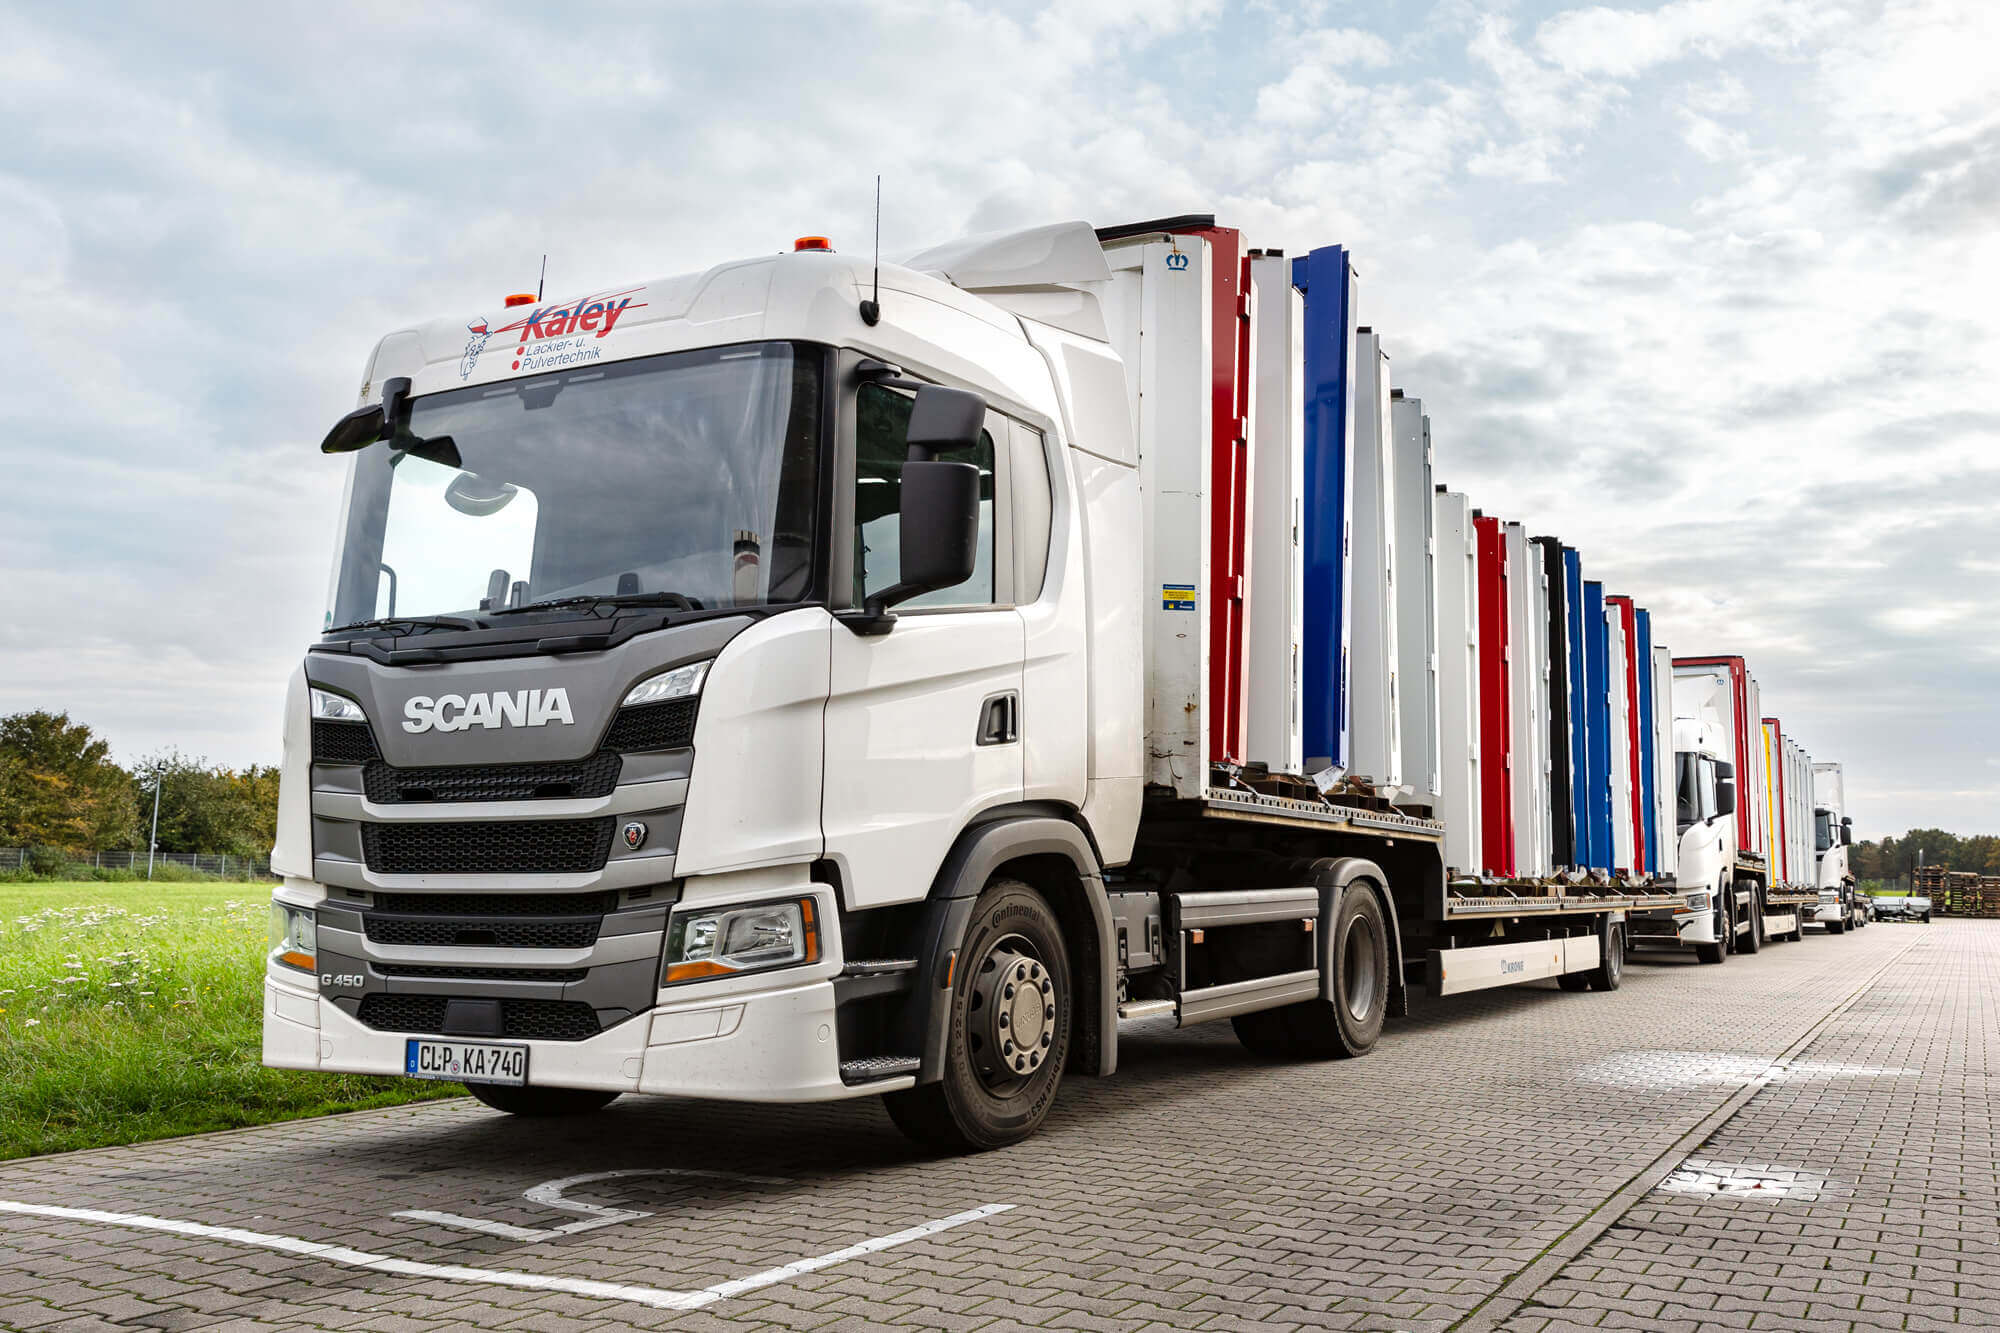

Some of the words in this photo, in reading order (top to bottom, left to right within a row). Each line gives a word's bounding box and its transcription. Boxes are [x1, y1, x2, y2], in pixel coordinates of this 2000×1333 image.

[519, 298, 632, 342] Kaley
[521, 347, 602, 371] Pulvertechnik
[526, 341, 572, 356] Lackier-
[402, 687, 575, 734] SCANIA
[992, 902, 1040, 928] Continental
[321, 974, 332, 986] G
[333, 974, 364, 987] 450
[420, 1045, 452, 1072] CLP
[491, 1050, 523, 1077] 740
